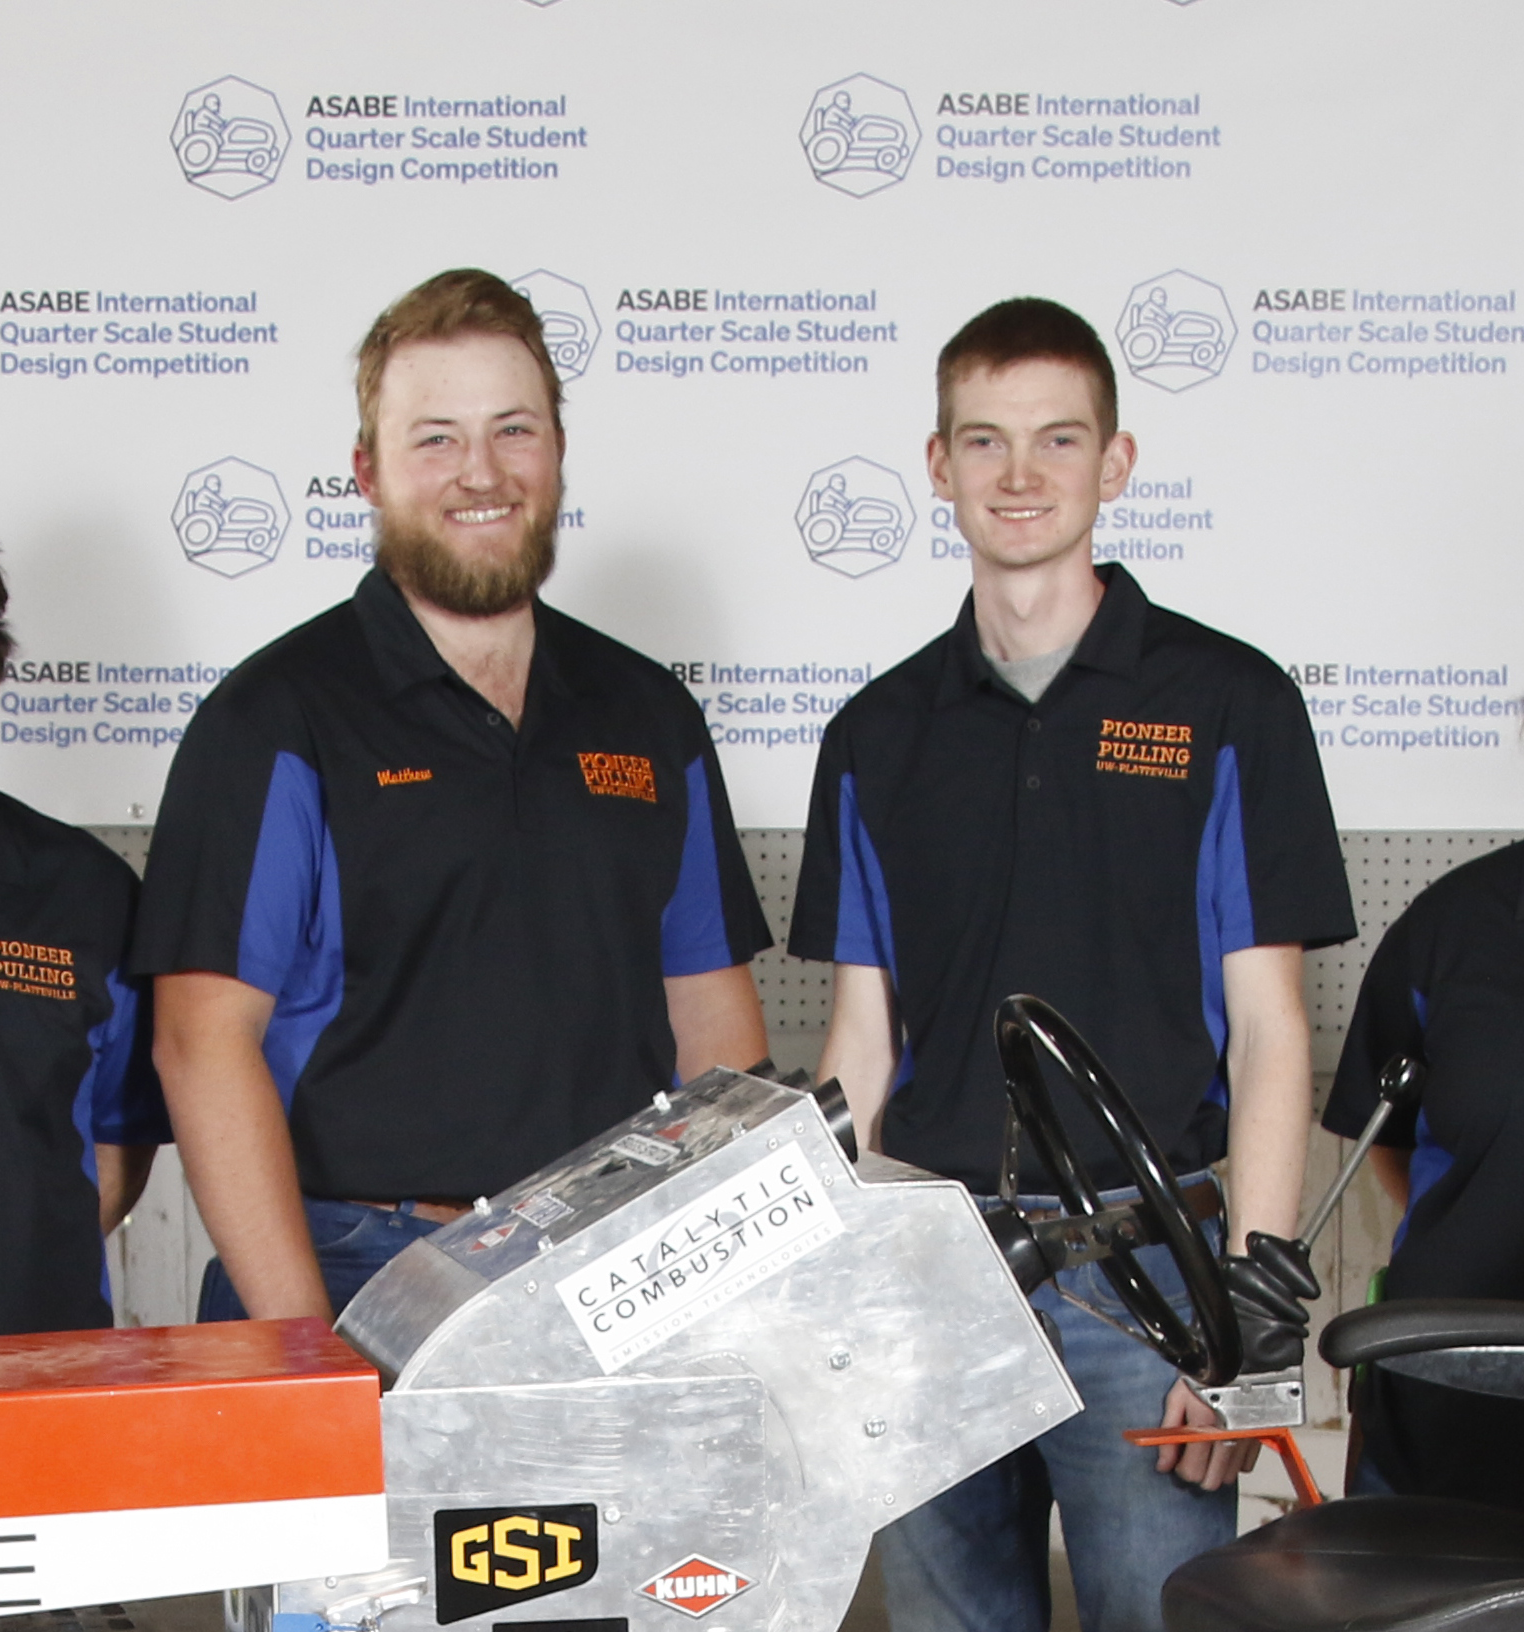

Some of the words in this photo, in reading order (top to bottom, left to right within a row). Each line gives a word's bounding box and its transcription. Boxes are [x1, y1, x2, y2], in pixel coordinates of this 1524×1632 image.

[306, 95, 398, 118] ASABE
[405, 95, 565, 117] International
[937, 93, 1030, 116] ASABE
[1037, 94, 1199, 115] International
[306, 127, 405, 152] Quarter
[412, 126, 481, 149] Scale
[487, 126, 587, 148] Student
[937, 125, 1037, 149] Quarter
[1043, 125, 1113, 147] Scale
[1119, 124, 1220, 146] Student
[307, 158, 394, 185] Design
[401, 157, 558, 184] Competition
[937, 156, 1025, 183] Design
[1032, 156, 1190, 183] Competition
[0, 291, 90, 313] ASABE
[97, 291, 256, 313] International
[616, 289, 708, 312] ASABE
[715, 289, 876, 311] International
[1253, 289, 1345, 311] ASABE
[1353, 290, 1515, 311] International
[0, 322, 98, 346] Quarter
[104, 322, 172, 344] Scale
[178, 322, 278, 343] Student
[616, 320, 715, 345] Quarter
[721, 320, 791, 342] Scale
[797, 320, 897, 342] Student
[1253, 320, 1352, 344] Quarter
[1359, 321, 1428, 342] Scale
[0, 352, 87, 379] Design
[94, 352, 249, 379] Competition
[616, 351, 703, 378] Design
[711, 351, 868, 377] Competition
[1253, 352, 1340, 378] Design
[1348, 352, 1506, 378] Competition
[306, 477, 362, 497] ASA
[1112, 508, 1214, 529] Student
[306, 537, 375, 563] Desig
[1092, 538, 1184, 562] petition
[3, 661, 91, 683] ASABE
[711, 662, 871, 684] International
[1287, 664, 1339, 685] ABE
[1345, 664, 1507, 686] International
[0, 691, 97, 715] Quarter
[103, 691, 172, 713] Scale
[717, 692, 786, 714] Scale
[1351, 694, 1421, 716] Scale
[0, 721, 87, 747] Design
[1101, 719, 1193, 743] PIONEER
[1341, 725, 1500, 751] Competition
[578, 752, 650, 775] PIONEER
[1098, 740, 1191, 766] PULLING
[377, 767, 433, 786] Matthew
[583, 769, 655, 793] PULLING
[1096, 760, 1188, 779] UW-PLATTEVILLE
[578, 1165, 799, 1307] CATALYTIC
[593, 1190, 814, 1332] COMBUSTION
[612, 1312, 693, 1363] EMISSION
[703, 1226, 832, 1307] TECHNOLOGIES
[451, 1515, 582, 1590] GSI
[655, 1573, 738, 1600] KUHN
